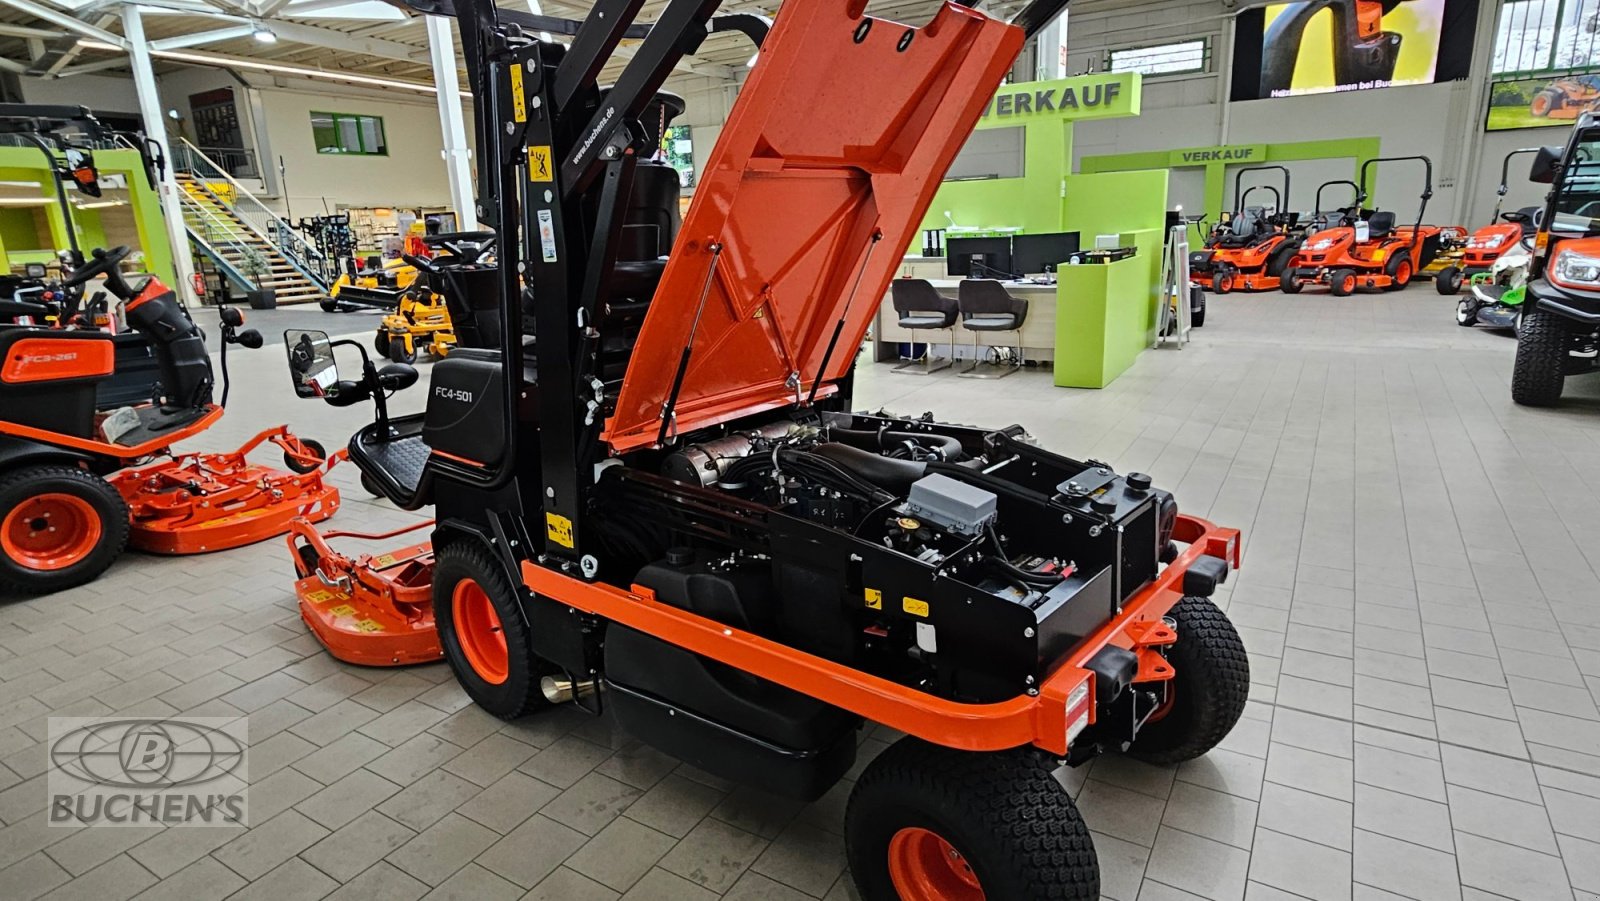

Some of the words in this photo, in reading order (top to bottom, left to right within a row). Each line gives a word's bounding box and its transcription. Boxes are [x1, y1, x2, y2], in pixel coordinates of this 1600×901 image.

[573, 106, 614, 165] www.buchens.de
[1182, 148, 1253, 162] VERKAUF
[23, 352, 77, 364] FC3-261
[435, 386, 472, 403] FC4-501
